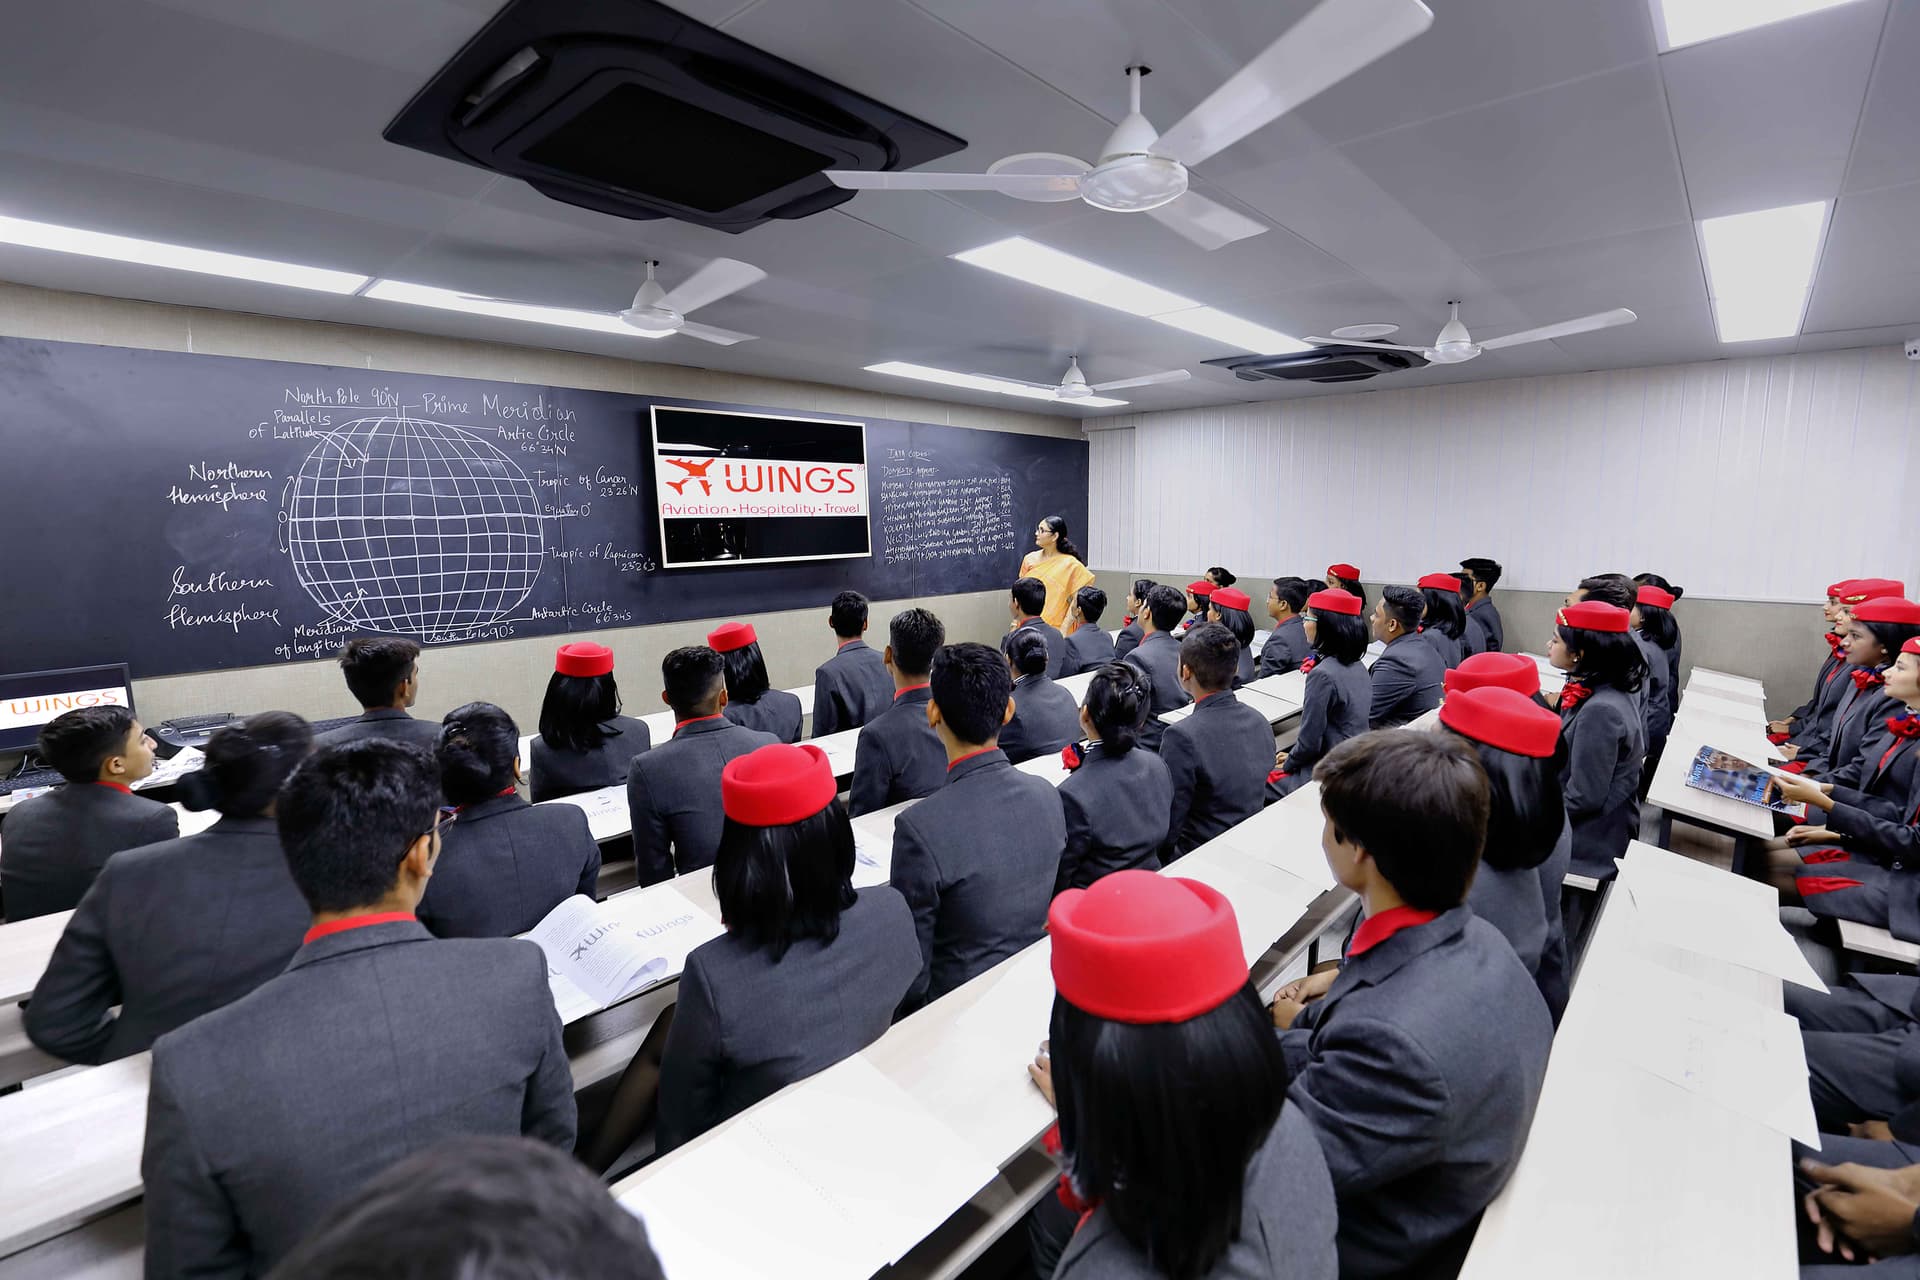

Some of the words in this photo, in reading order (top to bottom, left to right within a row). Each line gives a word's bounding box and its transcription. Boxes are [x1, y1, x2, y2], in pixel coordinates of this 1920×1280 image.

[284, 386, 333, 404] North
[337, 387, 360, 404] Pole
[422, 392, 470, 414] Prime
[482, 393, 577, 422] Meridian
[274, 409, 331, 425] Parallels
[274, 426, 320, 440] Latitude
[537, 424, 576, 442] Circle
[189, 461, 273, 482] Northern
[533, 470, 571, 494] Tropic
[579, 475, 592, 491] of
[595, 465, 627, 484] Cancer
[725, 464, 856, 494] WINGS
[166, 482, 268, 511] Hemisphere
[661, 503, 729, 515] Aviation
[739, 503, 816, 517] Hospitality
[824, 503, 861, 514] Travel
[589, 544, 600, 558] of
[167, 566, 274, 601] Southern
[581, 600, 614, 614] Circle
[164, 603, 282, 633] Hemisphere
[294, 621, 358, 638] Meridians
[275, 643, 291, 659] of
[11, 690, 118, 715] WINGS
